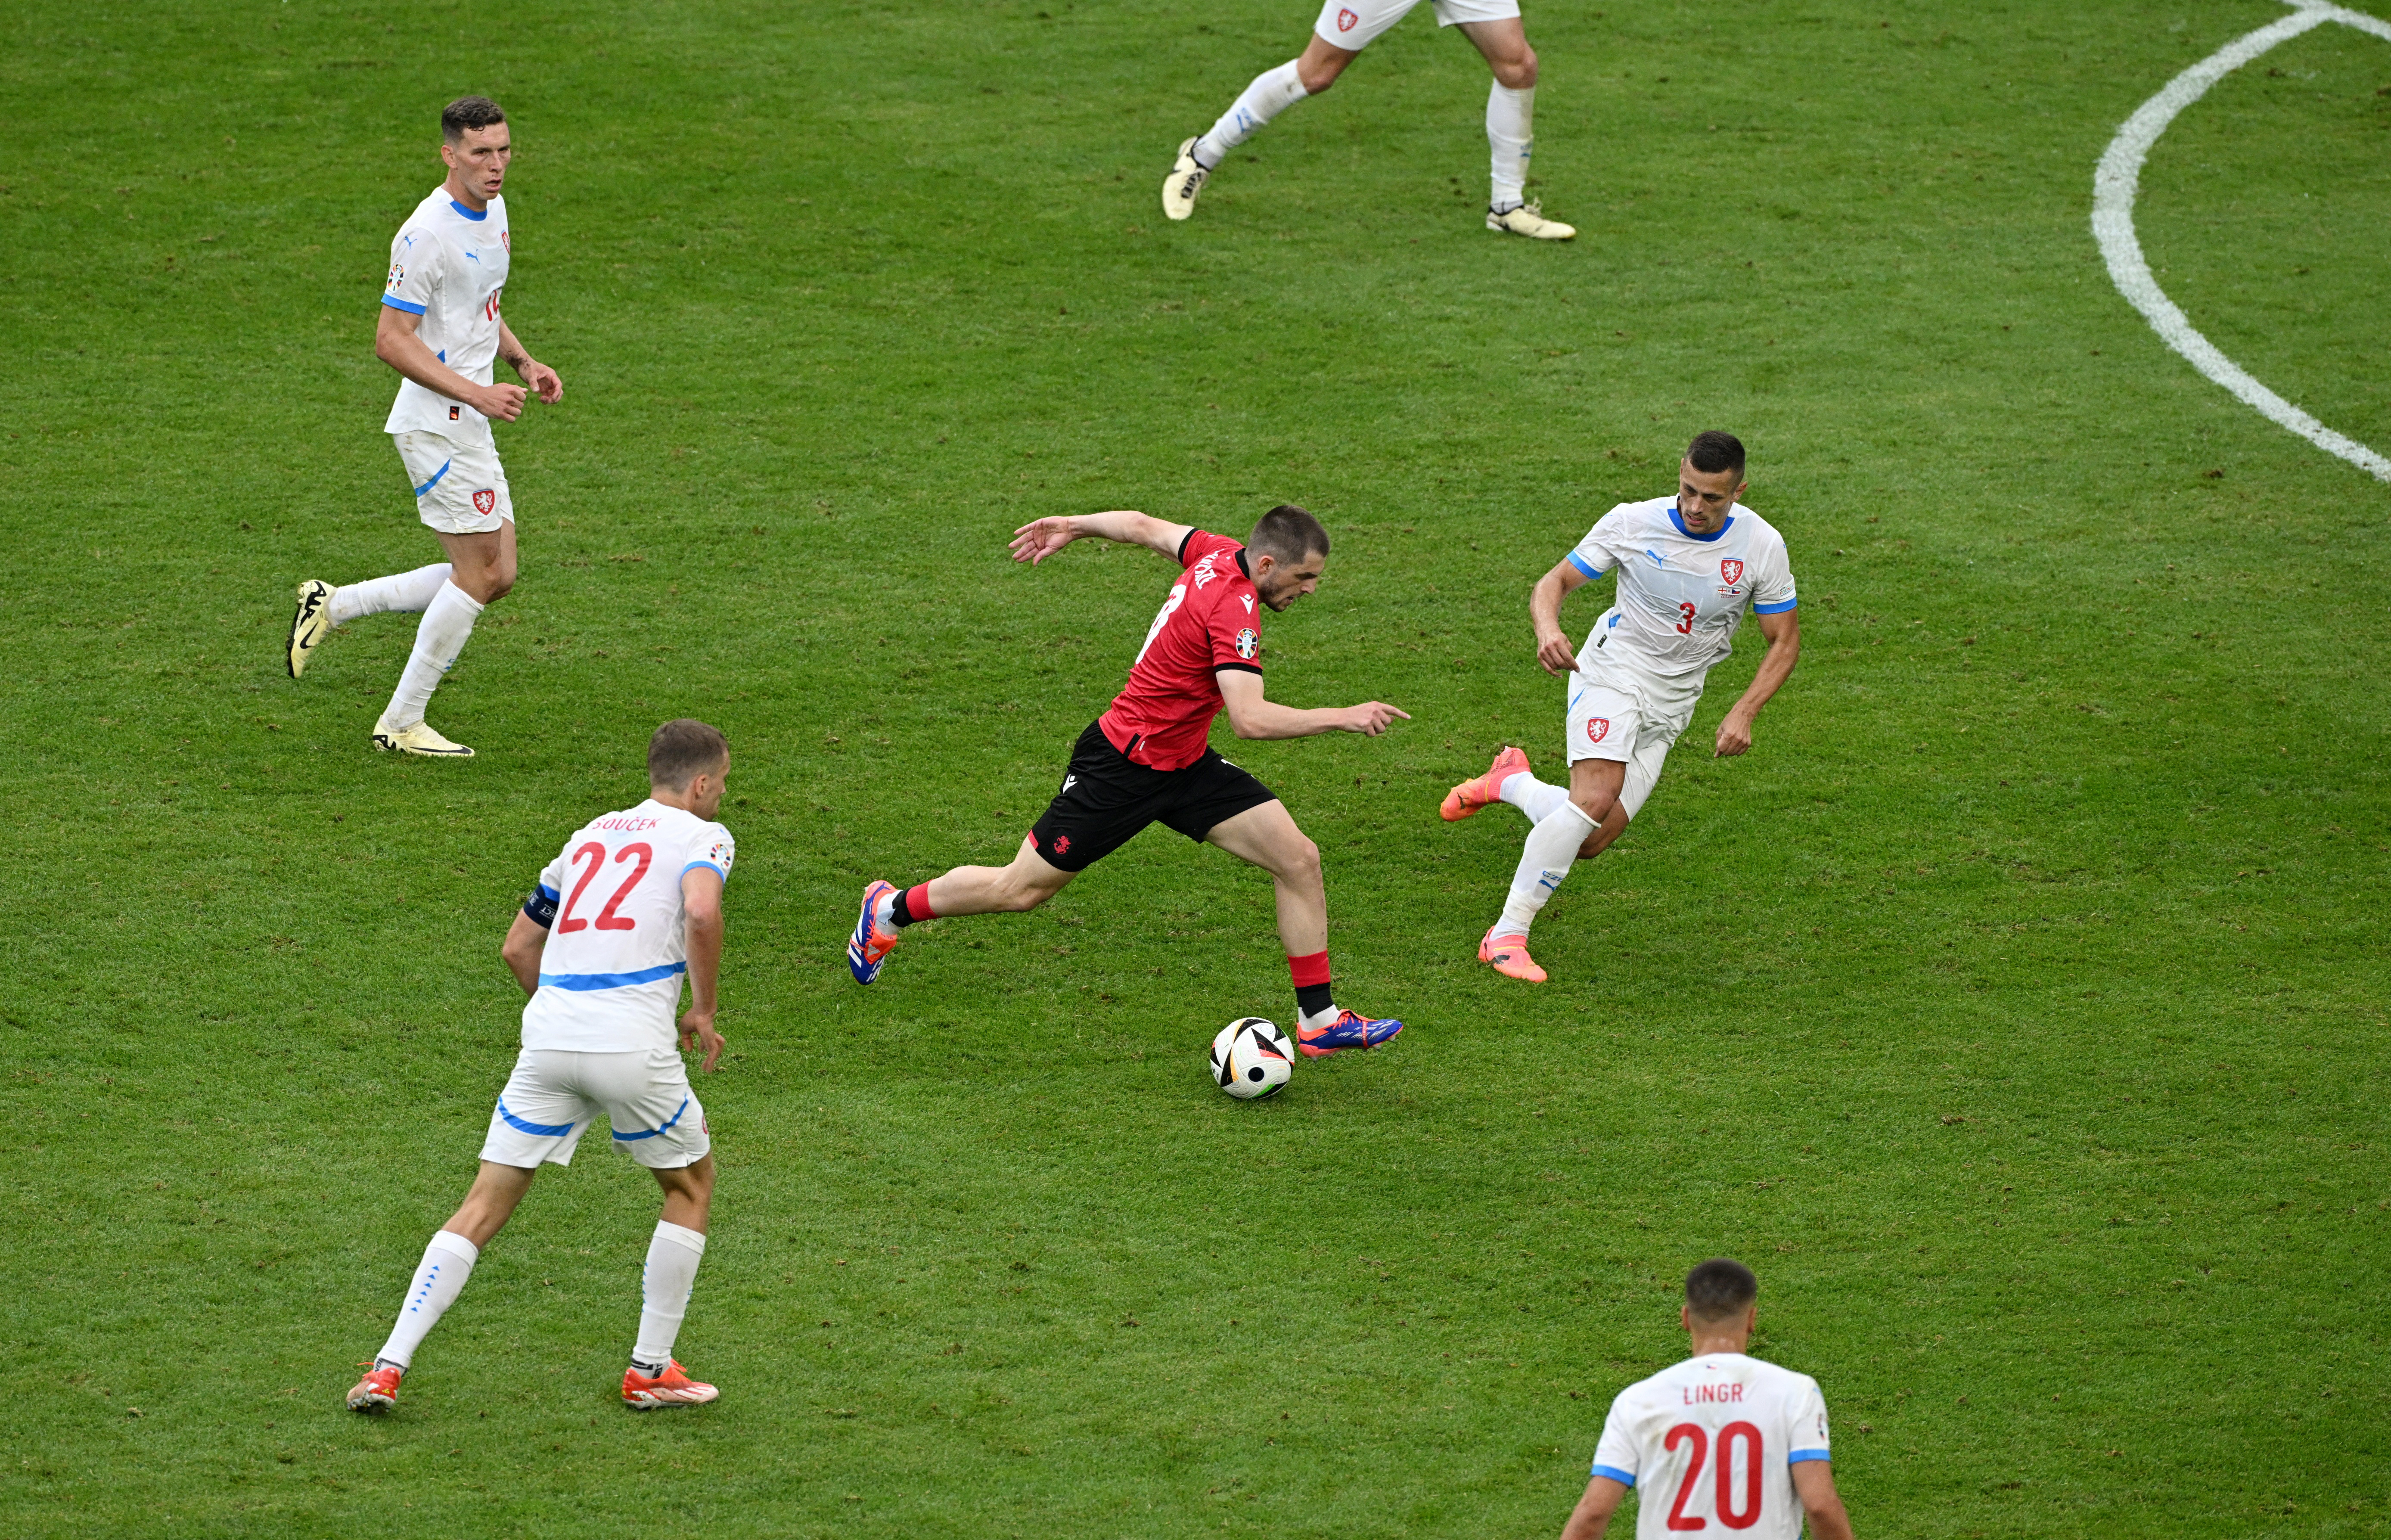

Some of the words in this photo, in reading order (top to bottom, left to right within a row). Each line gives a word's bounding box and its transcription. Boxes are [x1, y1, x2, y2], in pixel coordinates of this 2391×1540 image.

[1677, 602, 1696, 635] 3
[592, 816, 662, 831] SOUČEK
[558, 841, 653, 934] 22
[1683, 1383, 1743, 1405] LINGR
[1664, 1421, 1763, 1531] 20
